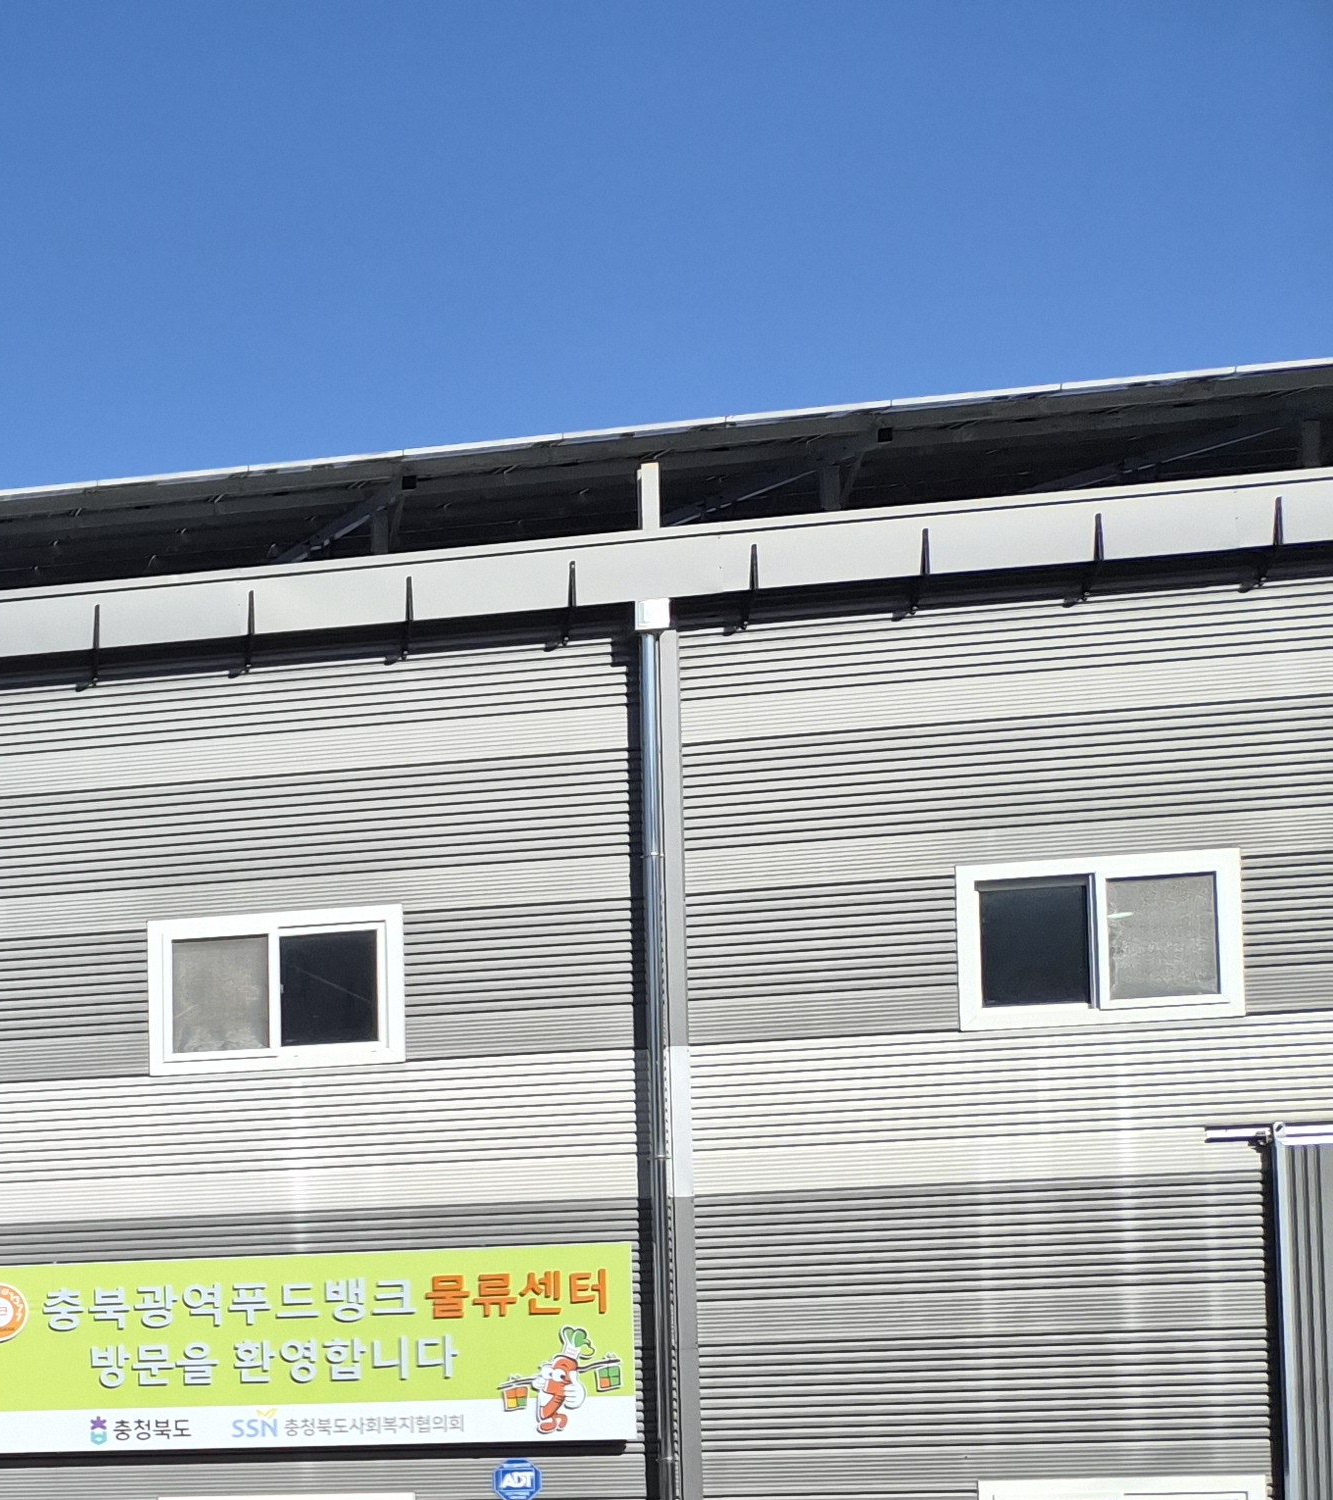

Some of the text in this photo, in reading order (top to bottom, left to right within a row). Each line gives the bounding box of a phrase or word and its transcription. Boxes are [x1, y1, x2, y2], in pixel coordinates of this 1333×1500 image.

[43, 1269, 607, 1331] 충북광역푸드뱅크 물류센터
[90, 1334, 460, 1389] 방문을 환영합니다
[113, 1418, 192, 1441] 충청북도
[231, 1414, 465, 1438] SSN 충청북도사회복지협의회
[500, 1471, 534, 1489] ADT
